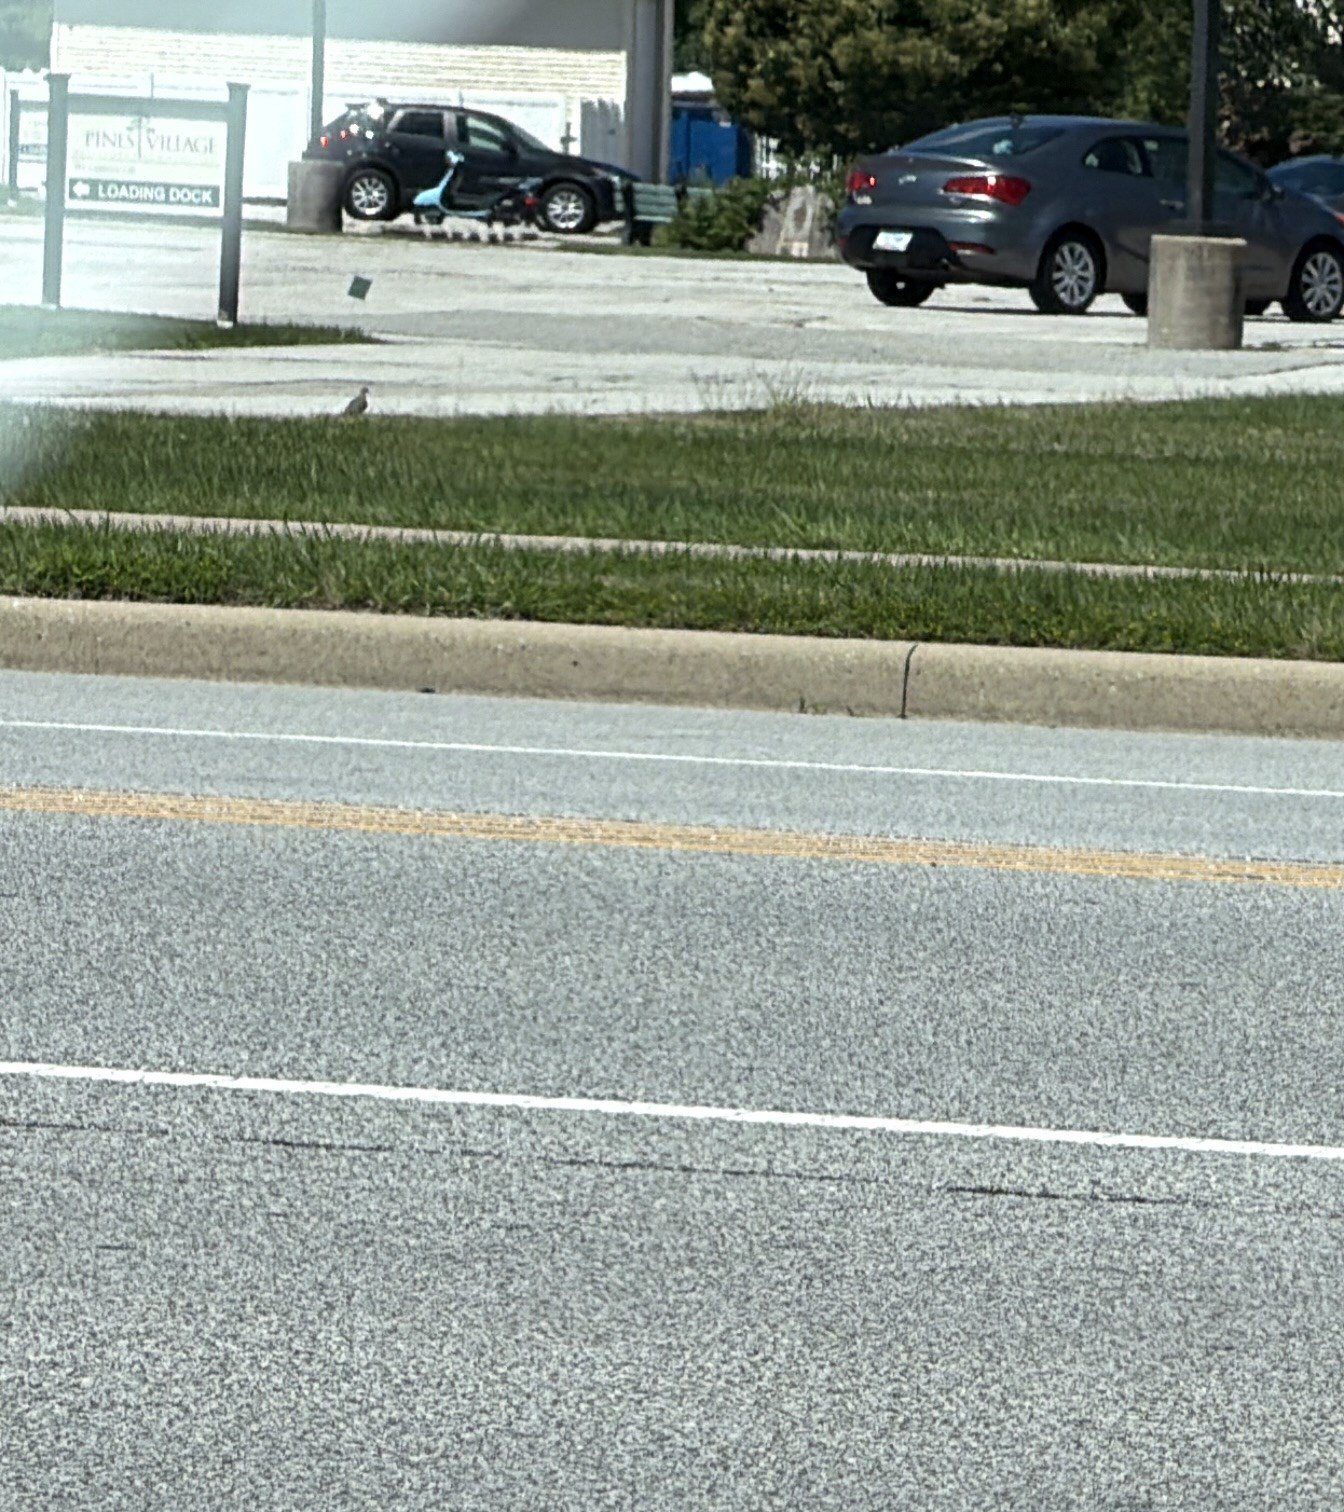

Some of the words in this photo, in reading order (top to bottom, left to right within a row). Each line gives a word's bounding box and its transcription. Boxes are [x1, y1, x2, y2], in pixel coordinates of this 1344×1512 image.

[85, 130, 135, 148] PINES
[146, 132, 215, 155] VILLAGE
[98, 184, 165, 201] LOADING
[169, 188, 212, 203] DOCK
